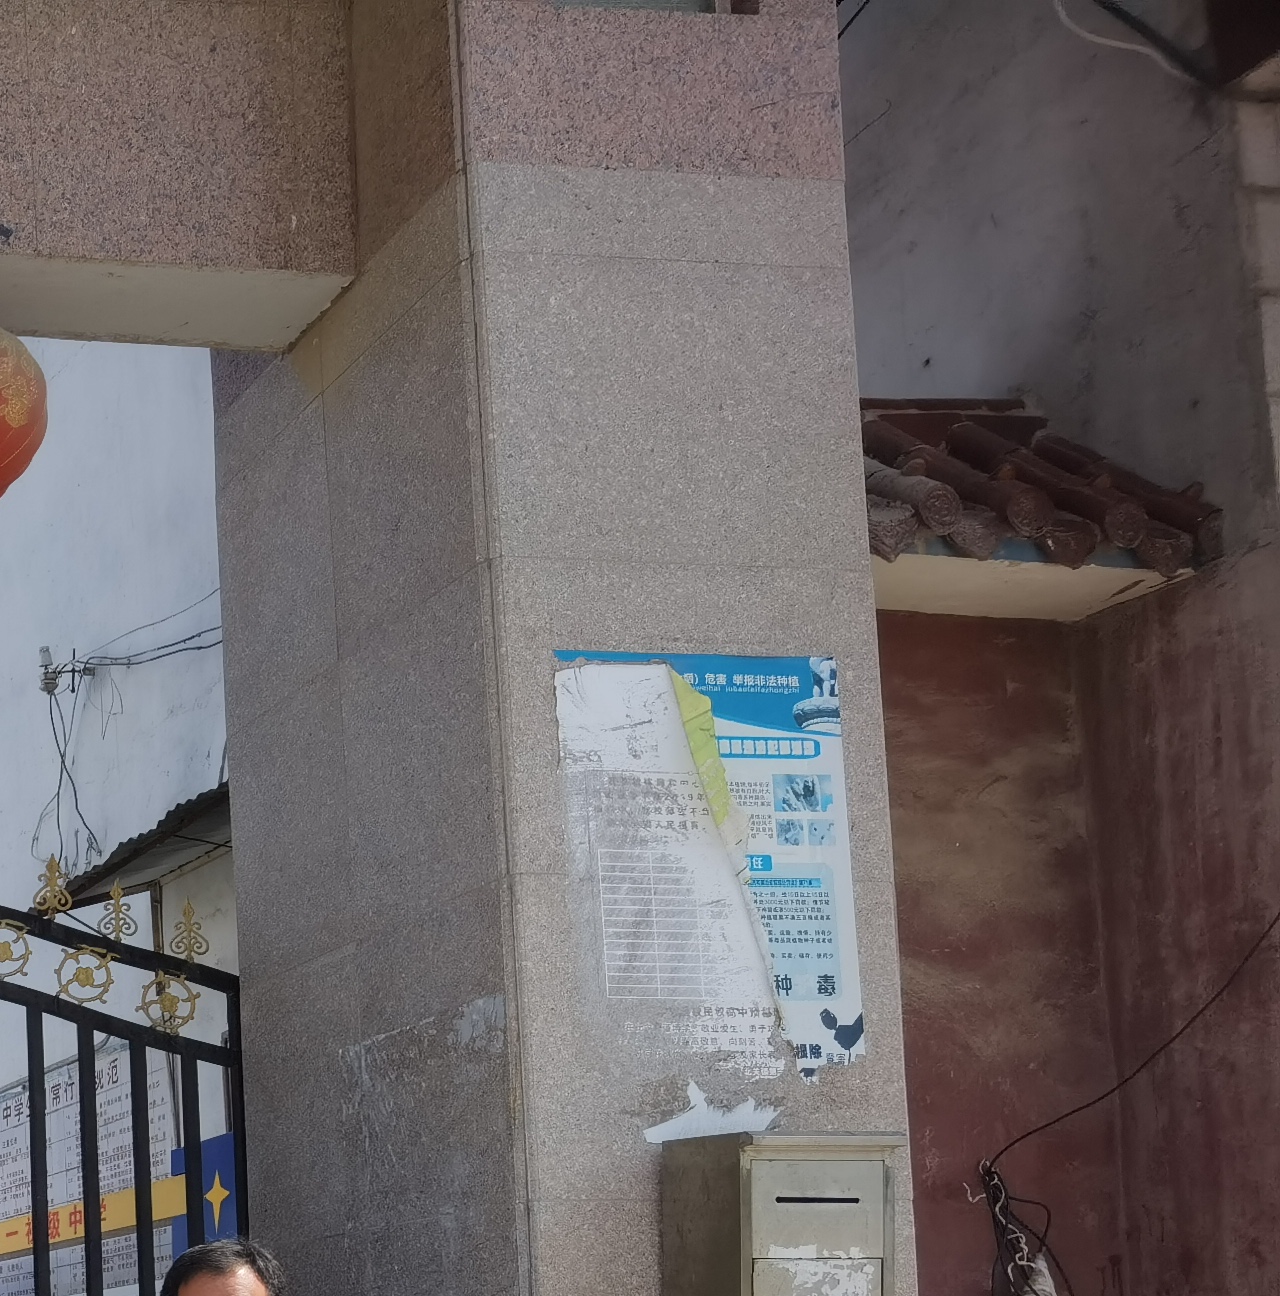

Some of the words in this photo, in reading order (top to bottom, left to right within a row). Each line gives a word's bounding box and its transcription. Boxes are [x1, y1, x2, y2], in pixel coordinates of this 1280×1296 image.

[733, 674, 800, 687] 举报非法种植
[816, 974, 837, 997] 毒
